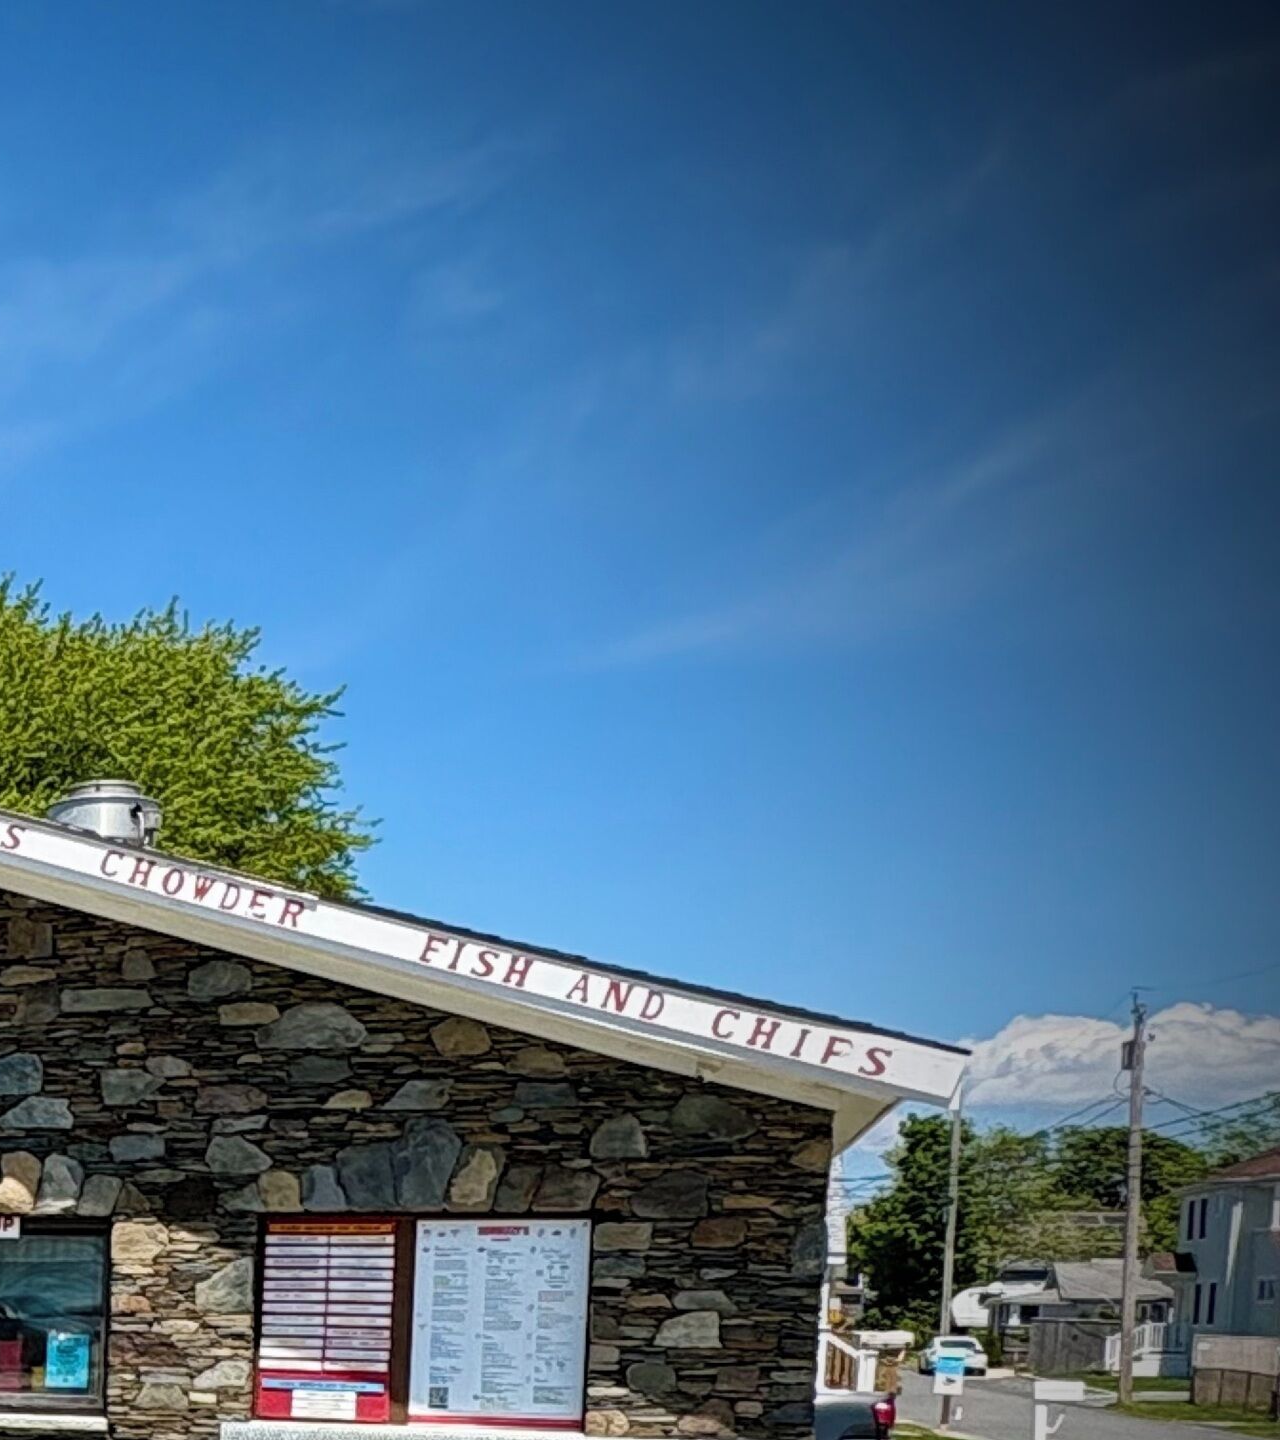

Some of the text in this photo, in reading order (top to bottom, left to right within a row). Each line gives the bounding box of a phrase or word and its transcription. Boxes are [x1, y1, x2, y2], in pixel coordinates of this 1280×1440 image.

[100, 850, 306, 927] CHOWDER
[419, 933, 535, 988] FISH
[565, 973, 666, 1021] AND
